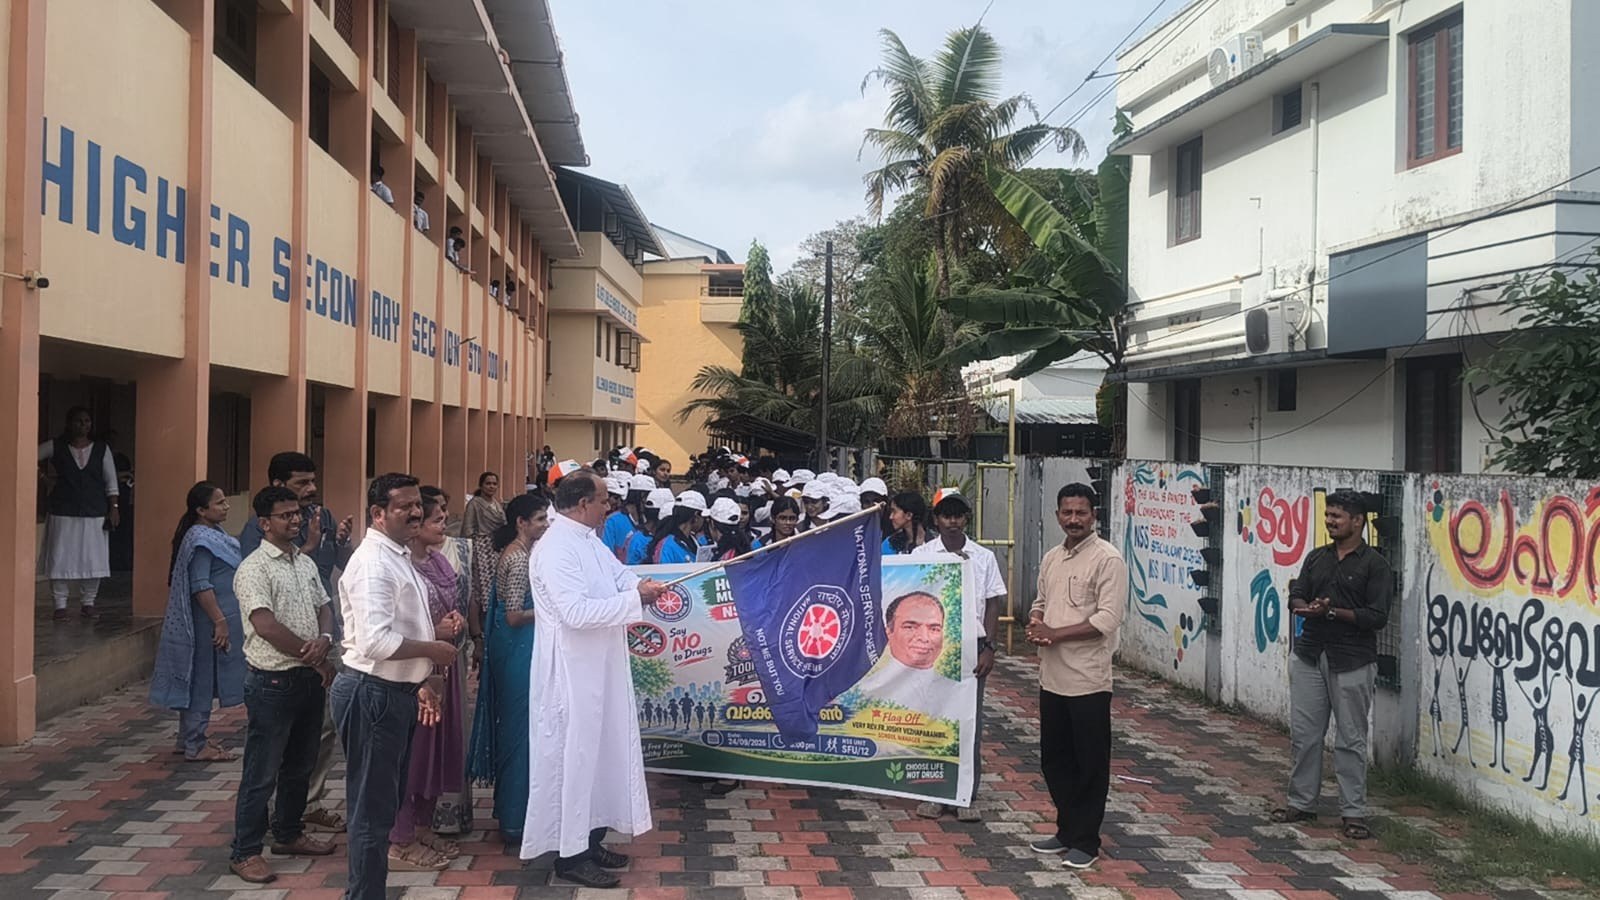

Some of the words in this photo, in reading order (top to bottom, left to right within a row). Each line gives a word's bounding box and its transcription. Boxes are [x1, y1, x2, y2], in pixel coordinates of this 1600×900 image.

[273, 236, 400, 343] SECONARY
[1256, 486, 1310, 567] Say
[854, 524, 868, 583] NATIONAL
[669, 627, 687, 637] Say
[755, 628, 767, 647] NOT
[672, 633, 701, 653] NO
[674, 653, 683, 662] to
[684, 646, 713, 661] Drugs
[905, 712, 922, 723] Off
[905, 763, 929, 771] CHOOSE
[931, 762, 944, 771] LIFE
[906, 771, 920, 779] NOT
[921, 770, 944, 779] DRUGS
